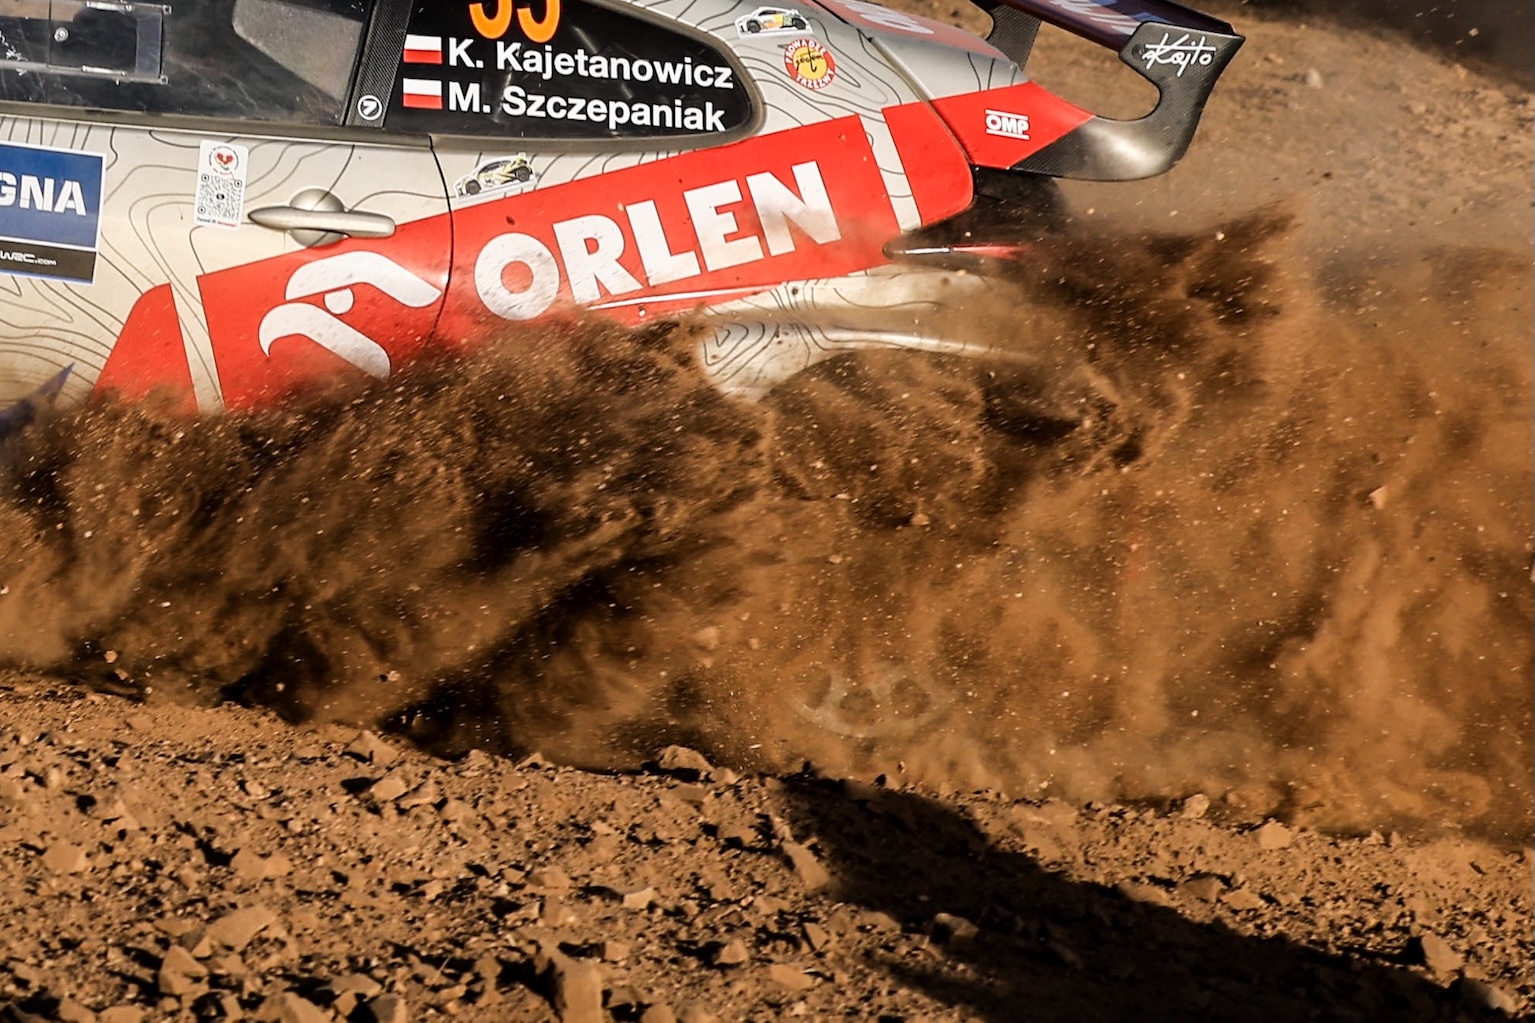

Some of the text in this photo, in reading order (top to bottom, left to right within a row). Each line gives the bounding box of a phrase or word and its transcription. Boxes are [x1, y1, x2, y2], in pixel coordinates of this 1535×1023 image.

[448, 37, 734, 89] K. Kajetanowicz
[448, 81, 726, 132] M. Szczepaniak
[985, 114, 1029, 136] OMP
[474, 161, 841, 321] ORLEN
